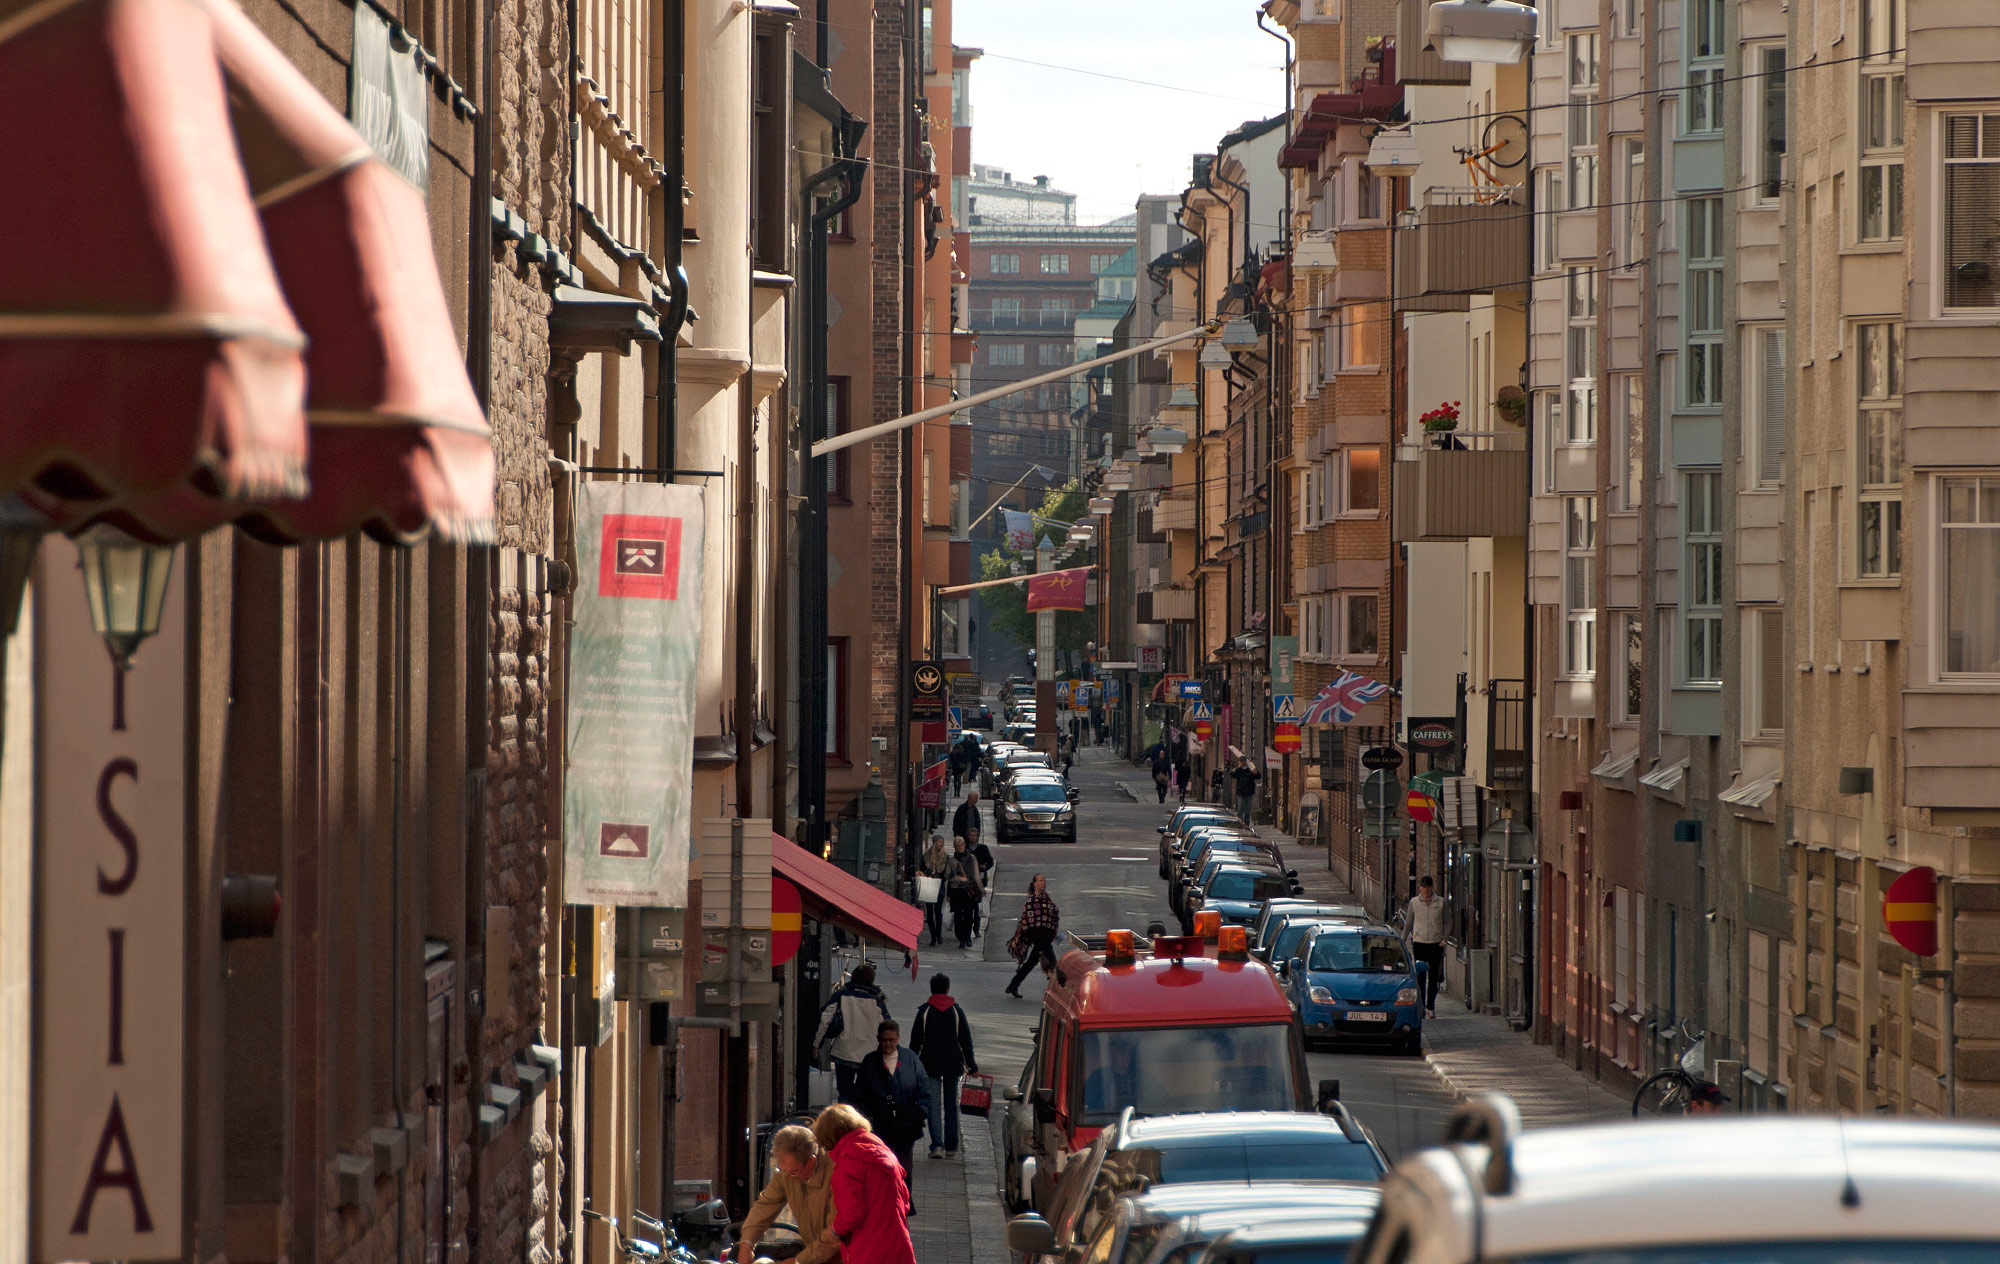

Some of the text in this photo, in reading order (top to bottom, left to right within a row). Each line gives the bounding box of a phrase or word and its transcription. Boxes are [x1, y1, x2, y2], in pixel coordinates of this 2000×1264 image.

[626, 643, 648, 655] Yoga
[619, 660, 652, 672] Qigong
[1349, 1012, 1363, 1020] JUL
